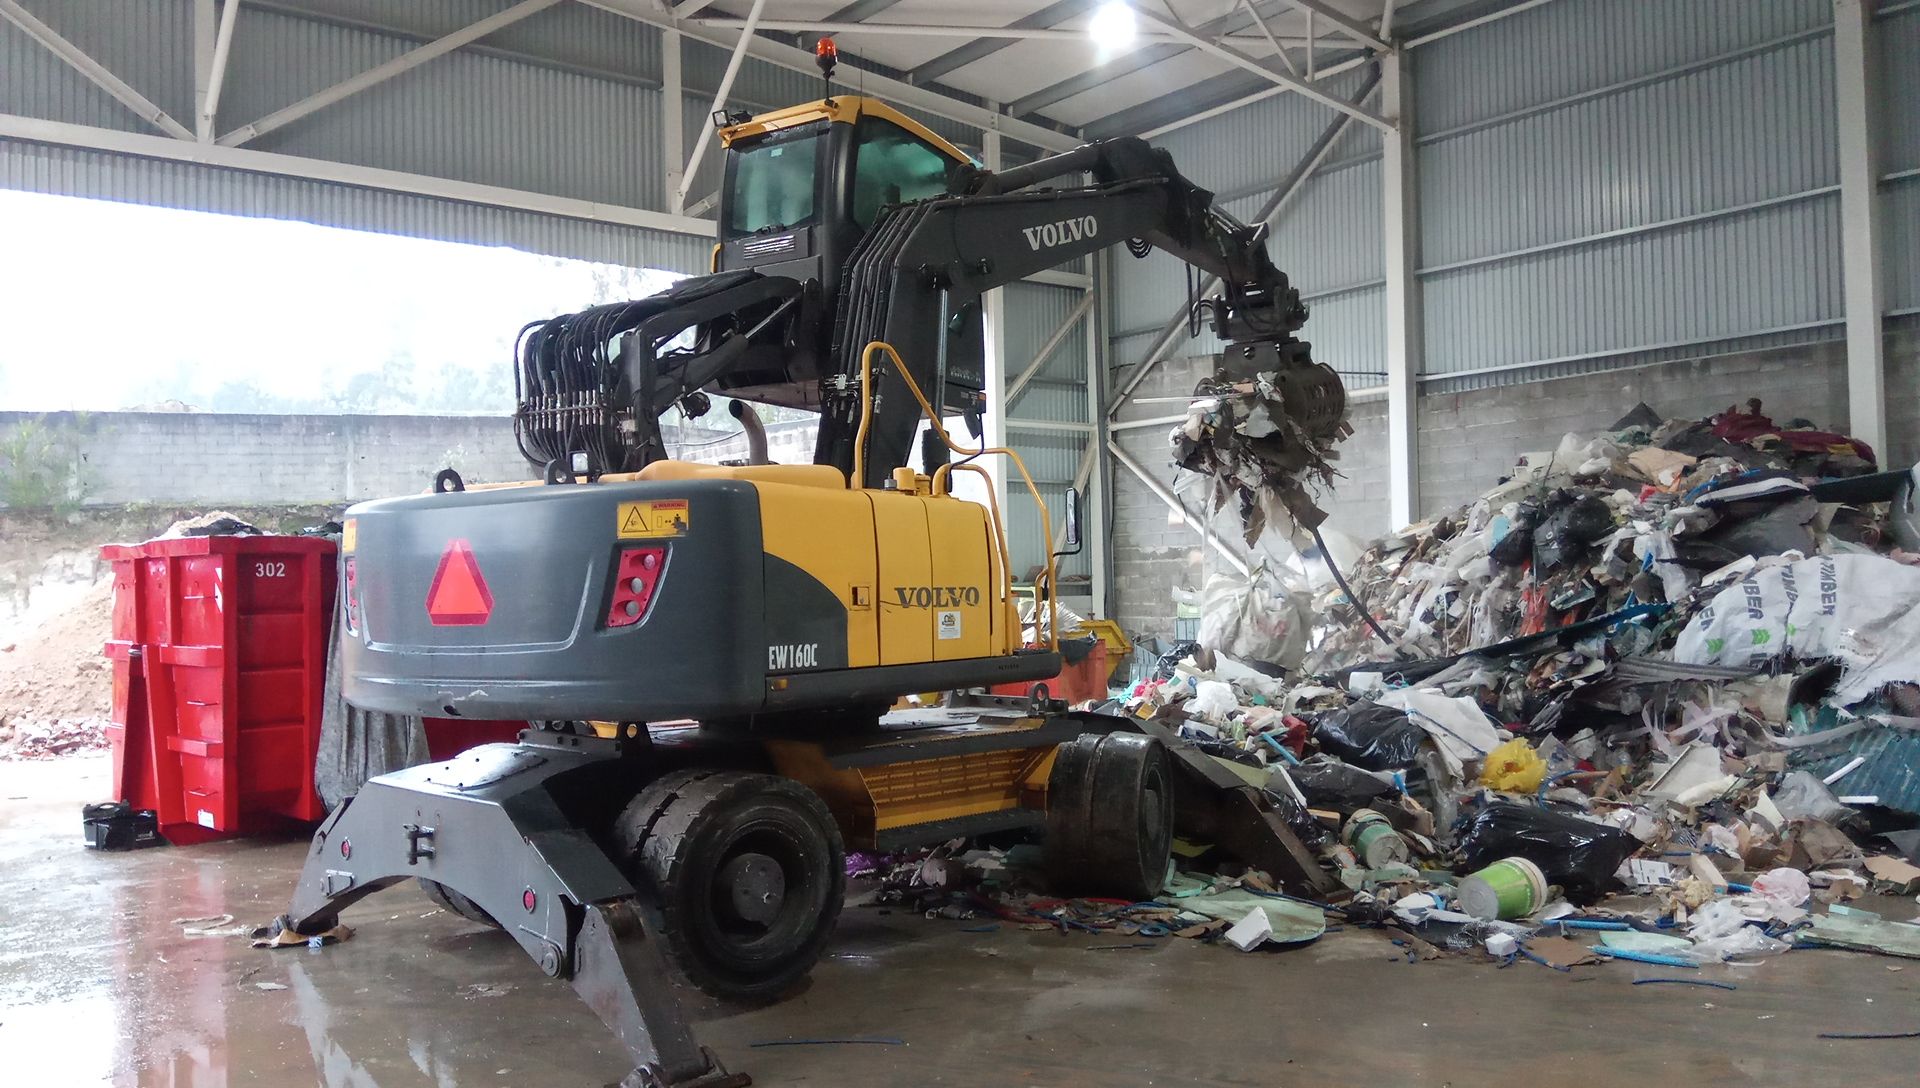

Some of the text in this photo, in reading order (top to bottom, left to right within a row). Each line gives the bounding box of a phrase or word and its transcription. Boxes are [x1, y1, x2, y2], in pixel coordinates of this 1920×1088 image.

[1022, 215, 1097, 251] VOLVO
[255, 562, 286, 577] 302
[894, 586, 980, 609] VOLVO
[768, 643, 818, 670] EW160C
